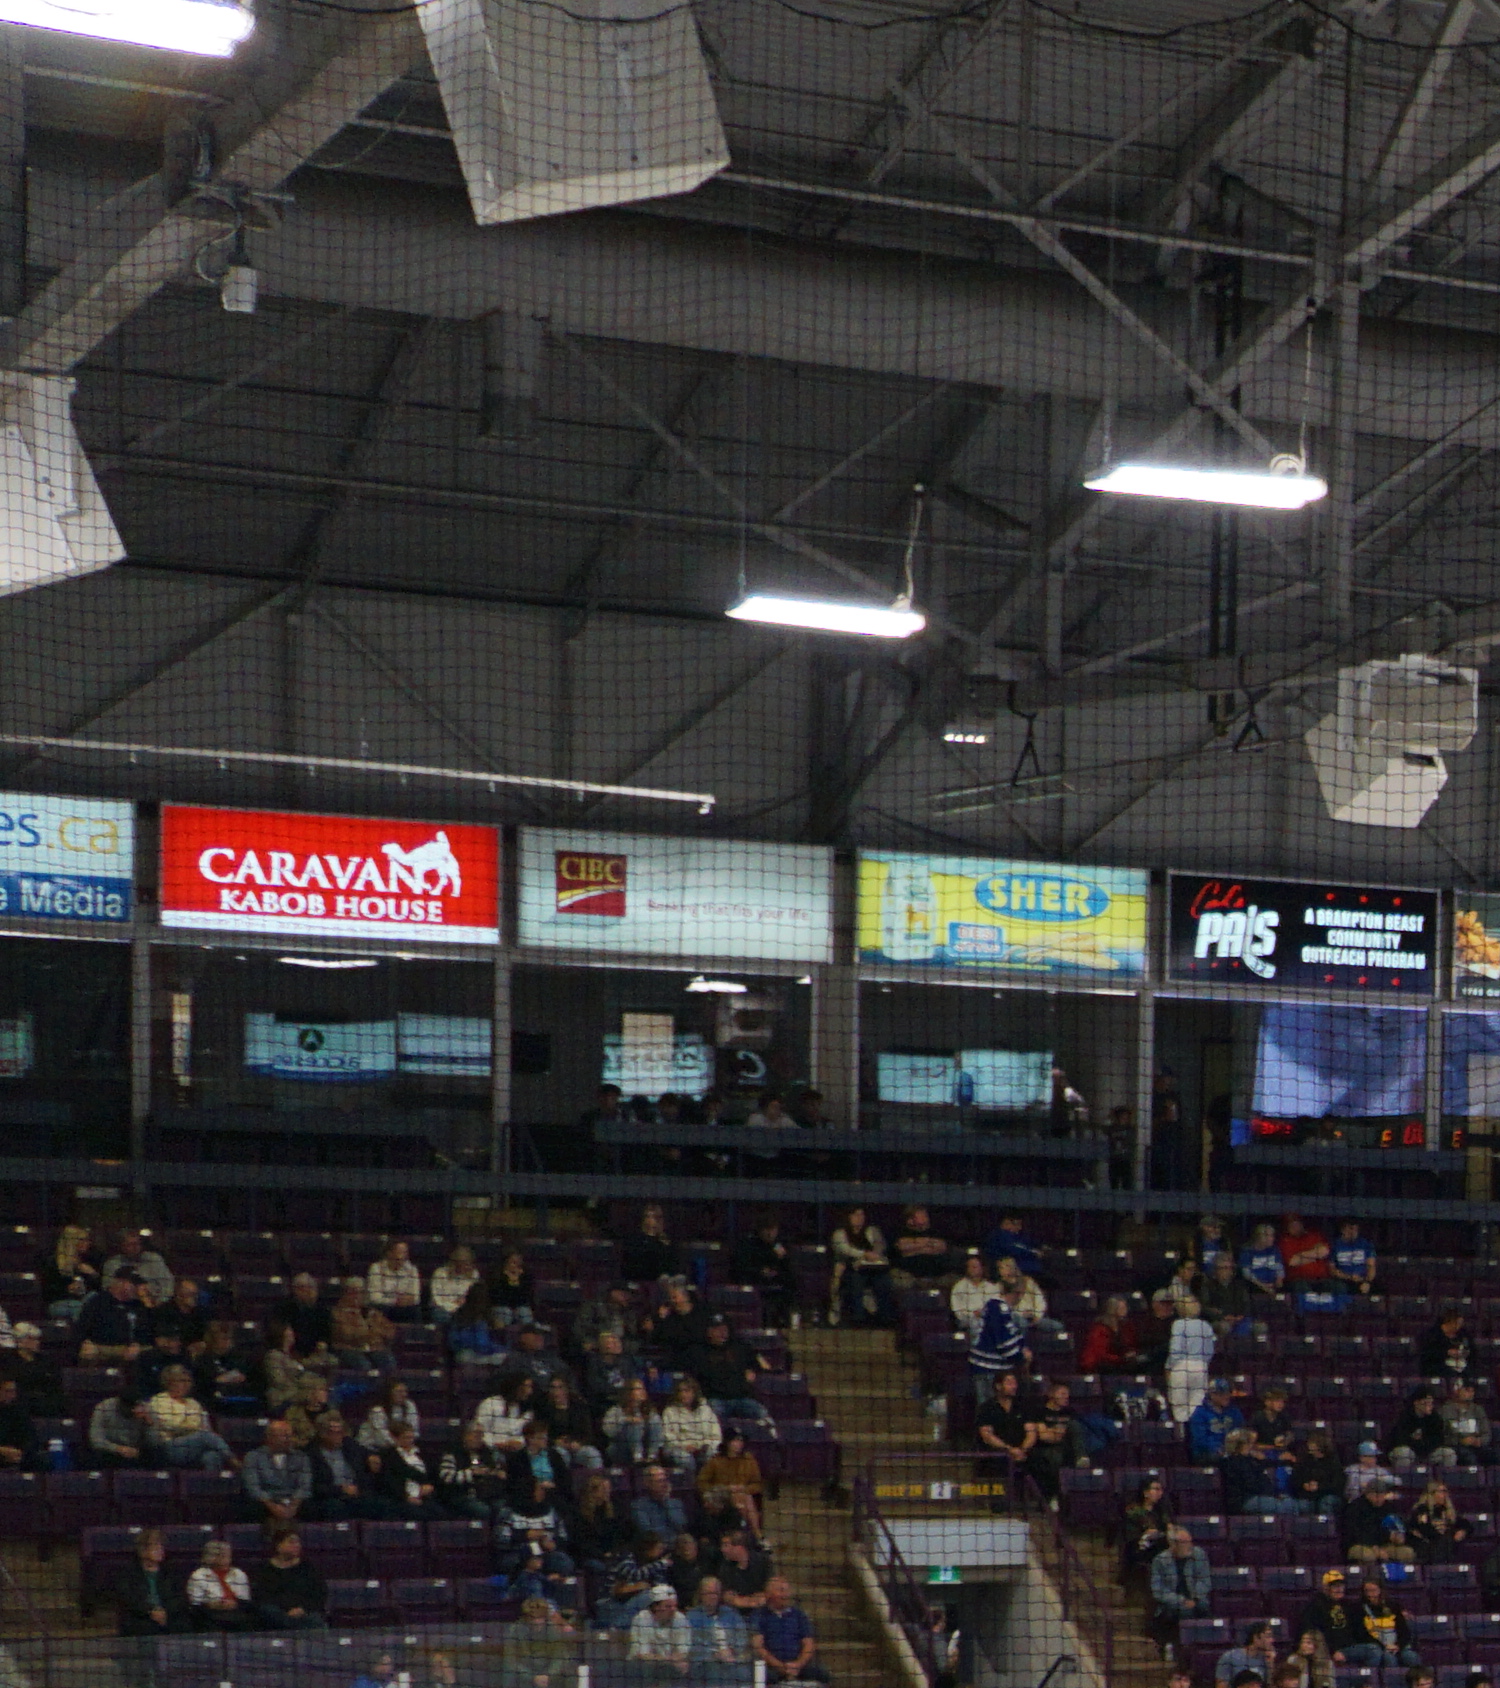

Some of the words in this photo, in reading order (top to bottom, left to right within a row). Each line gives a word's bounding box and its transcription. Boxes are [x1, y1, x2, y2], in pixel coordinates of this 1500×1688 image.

[199, 847, 426, 896] CARAVAN
[560, 857, 625, 883] CIBC
[20, 877, 122, 918] Media
[219, 889, 326, 917] KABOB
[335, 895, 443, 922] HOUSE
[985, 876, 1090, 916] SHER
[1304, 909, 1314, 925] A
[1317, 910, 1381, 931] BRAMPTON
[1386, 914, 1425, 932] BEAST
[1327, 930, 1401, 950] COMMUNITY
[1301, 947, 1365, 967] OUTREACH
[1368, 951, 1427, 970] PROGRAM
